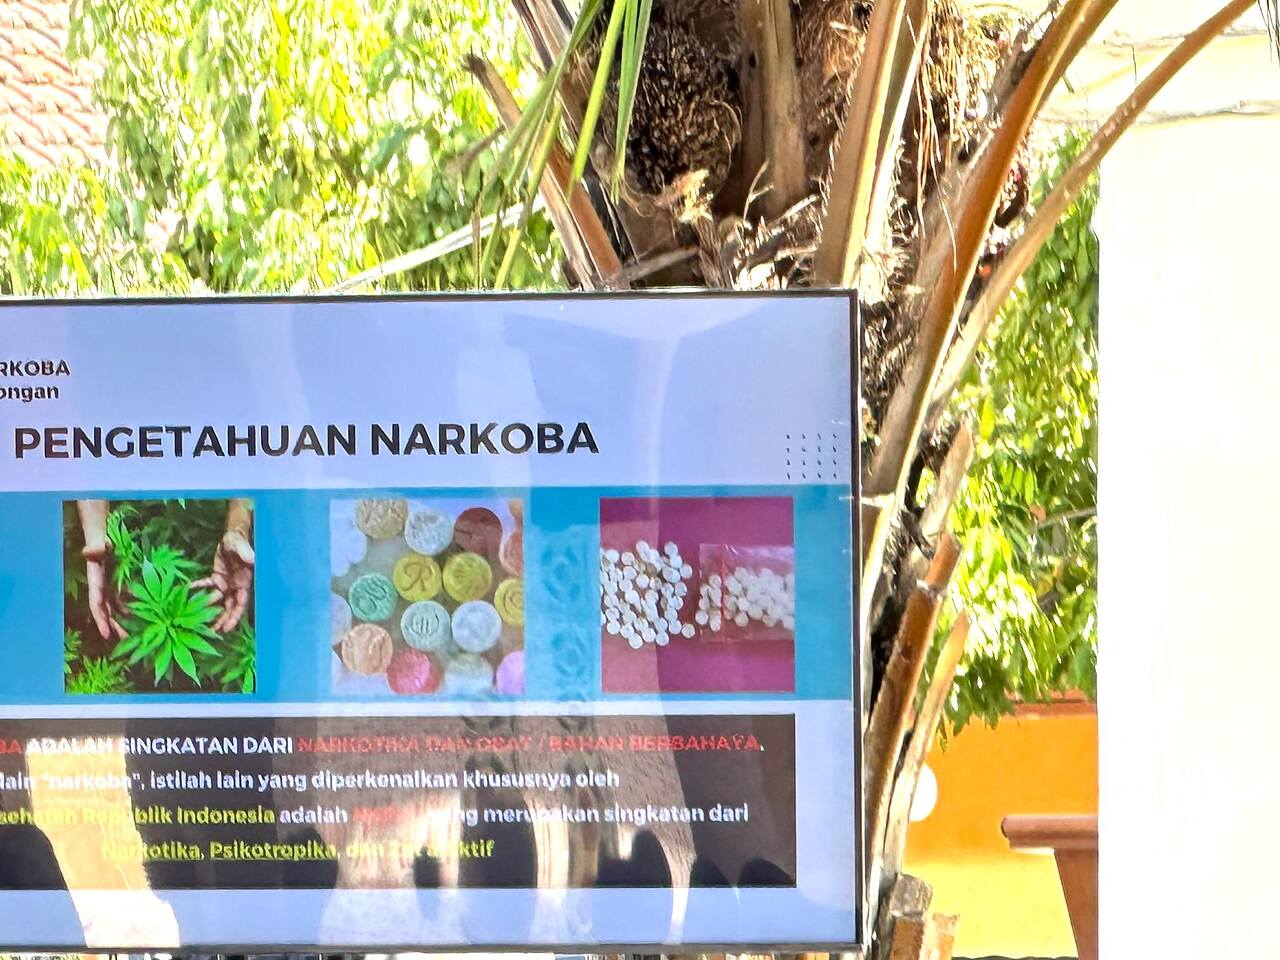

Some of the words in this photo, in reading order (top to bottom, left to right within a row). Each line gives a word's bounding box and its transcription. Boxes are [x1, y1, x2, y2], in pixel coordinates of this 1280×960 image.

[14, 424, 357, 459] PENGETAHUAN
[371, 421, 600, 456] NARKOBA
[25, 736, 114, 754] ADALAH
[121, 736, 238, 755] SINGKATAN
[243, 736, 293, 755] DARI
[150, 769, 212, 790] istilah
[216, 769, 254, 789] lain
[258, 772, 307, 791] yang
[311, 769, 458, 792] diperkenalkan
[463, 769, 570, 792] khususnya
[575, 769, 620, 788] oleh
[83, 804, 174, 825] Repblik
[177, 804, 276, 824] Indonesia
[279, 805, 349, 824] adalah
[604, 802, 705, 826] singkatan
[708, 802, 750, 823] dari
